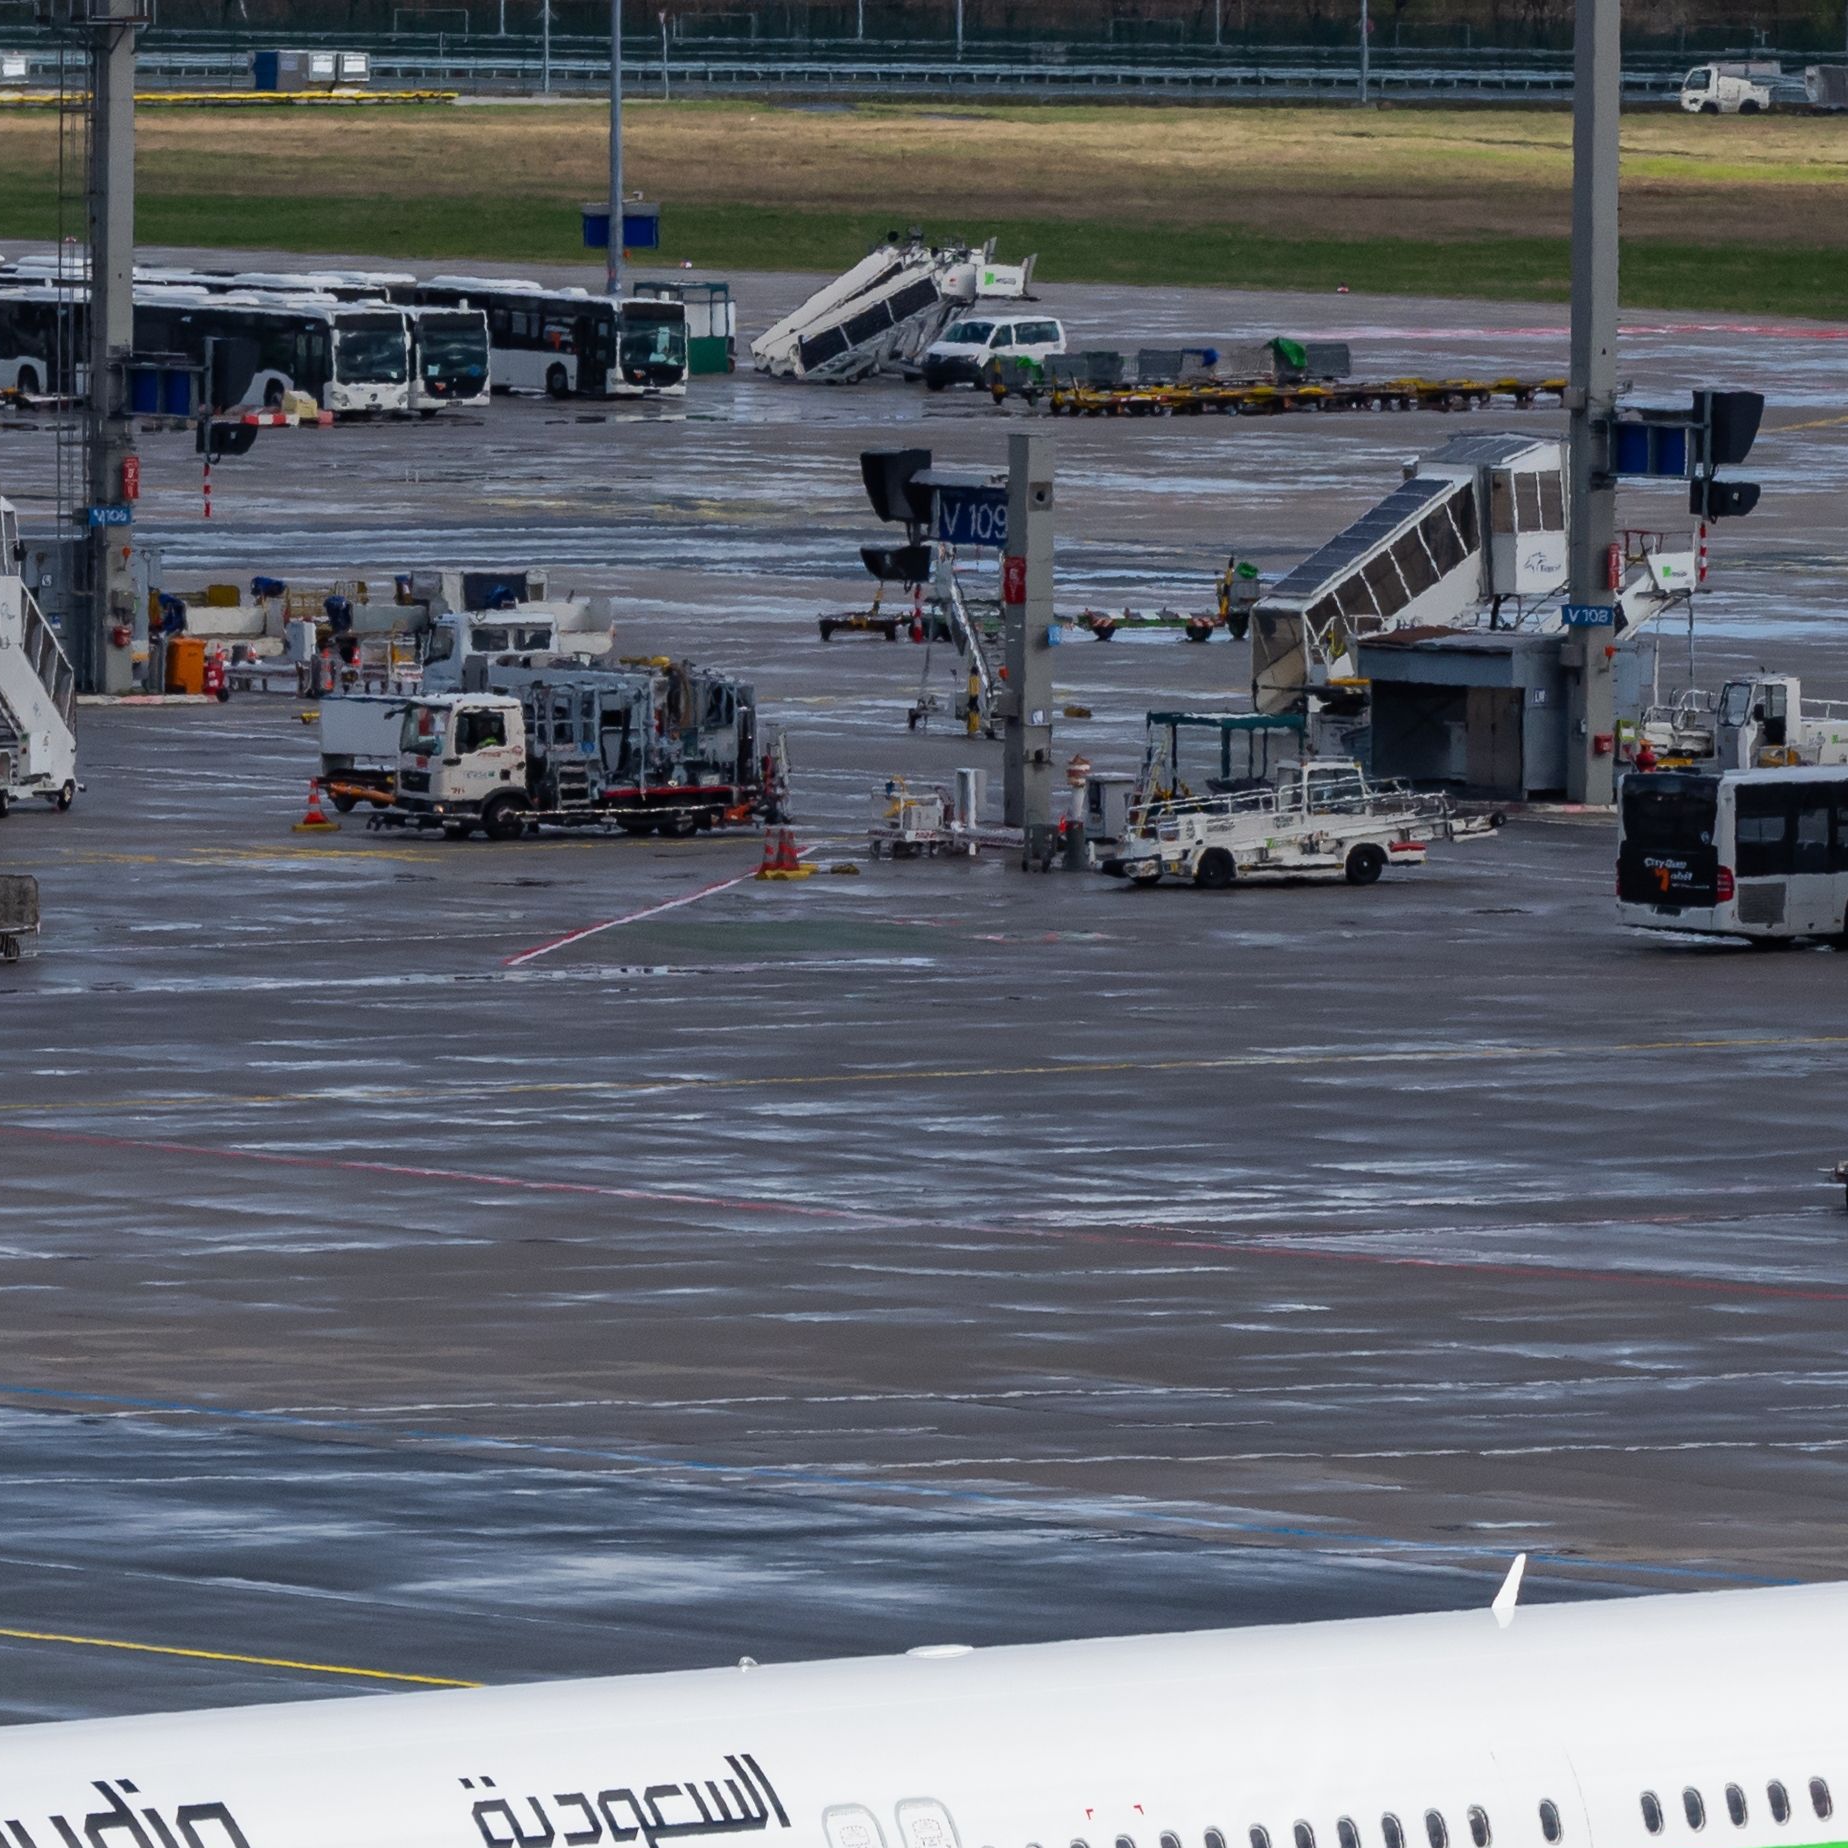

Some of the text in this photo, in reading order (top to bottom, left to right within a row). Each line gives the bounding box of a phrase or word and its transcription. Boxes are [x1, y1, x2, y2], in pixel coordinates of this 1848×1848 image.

[943, 502, 1008, 539] V 109
[1568, 608, 1578, 622] V
